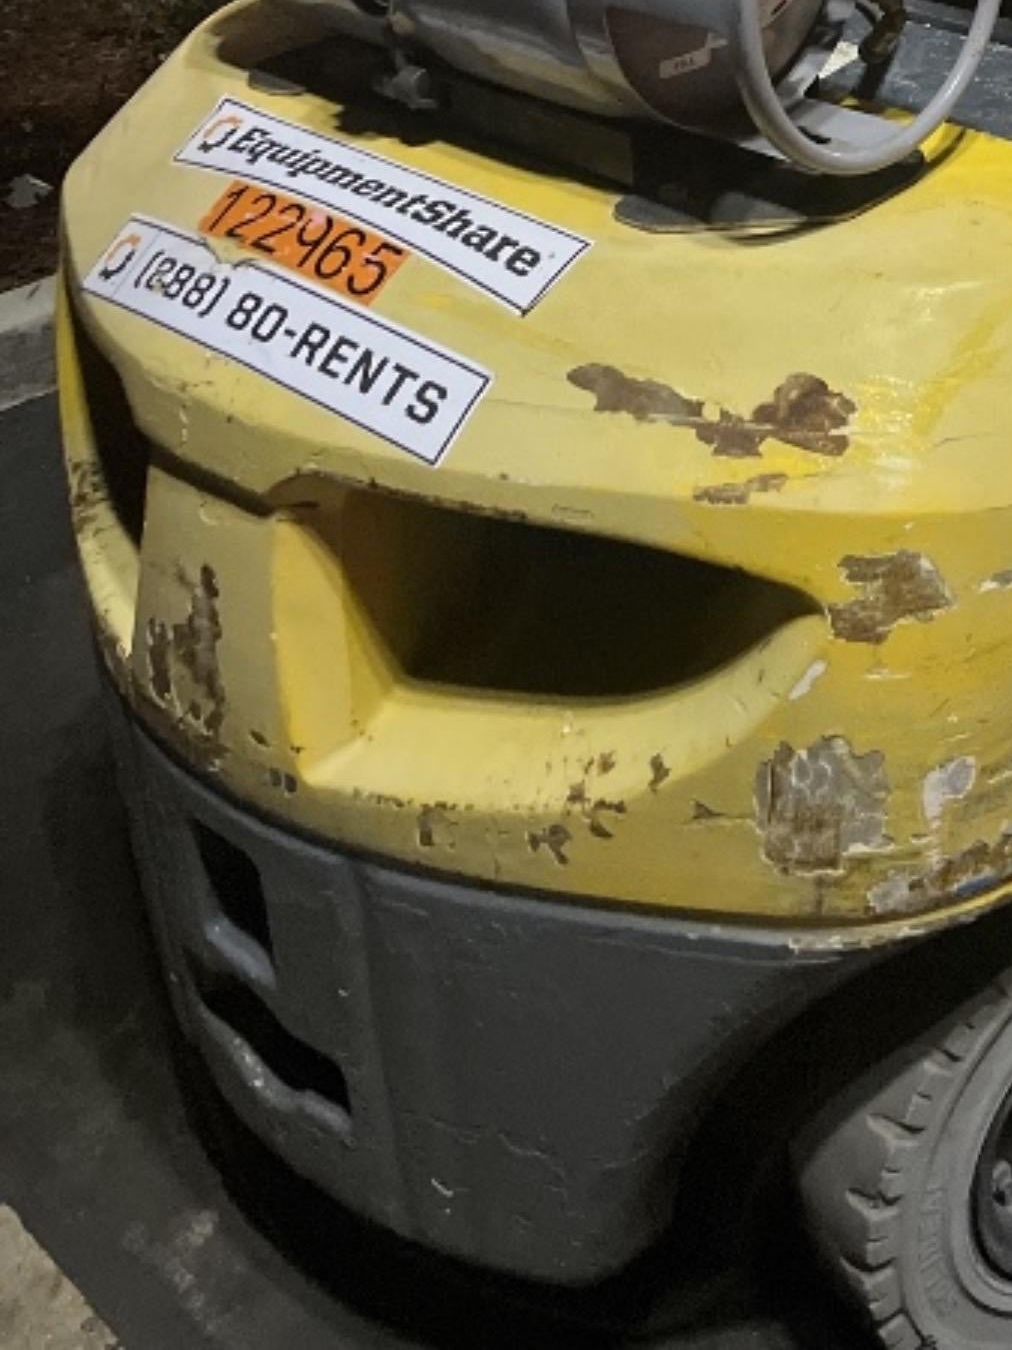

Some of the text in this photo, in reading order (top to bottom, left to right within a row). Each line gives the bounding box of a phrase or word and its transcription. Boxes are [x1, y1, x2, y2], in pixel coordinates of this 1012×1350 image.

[208, 186, 400, 297] 122965
[229, 127, 542, 278] EquipmentShare
[226, 291, 449, 425] 80-RENTS
